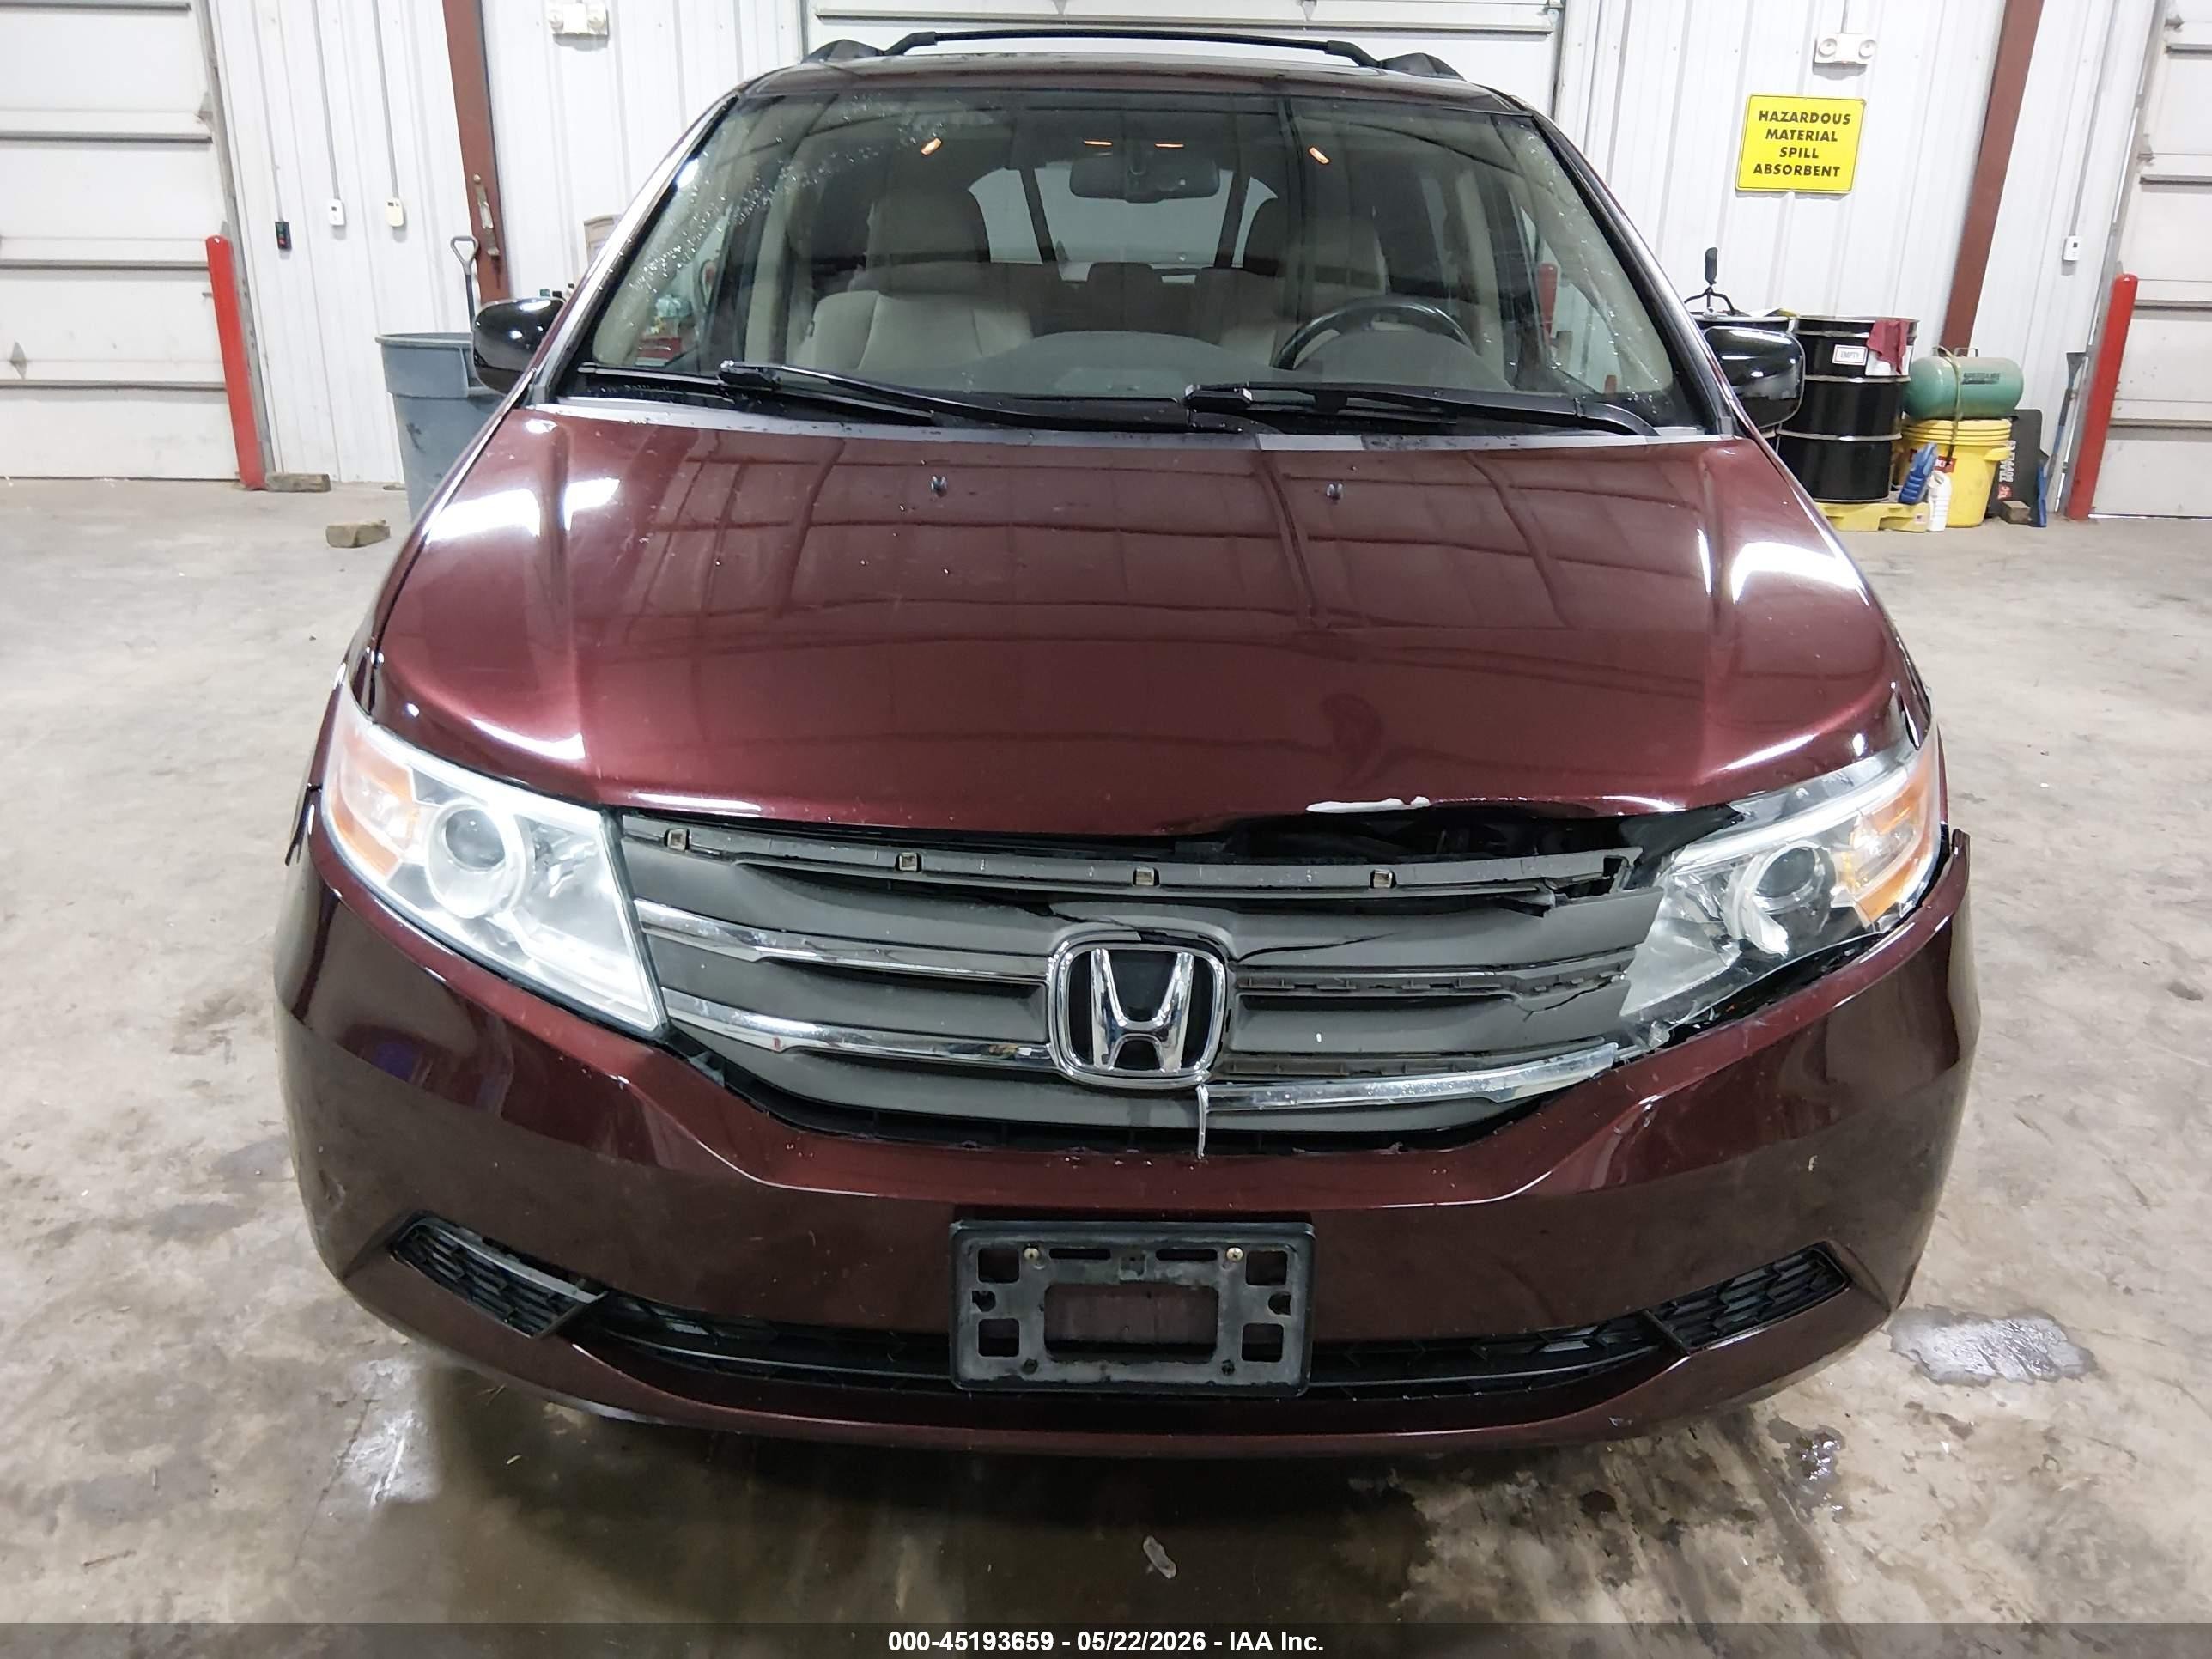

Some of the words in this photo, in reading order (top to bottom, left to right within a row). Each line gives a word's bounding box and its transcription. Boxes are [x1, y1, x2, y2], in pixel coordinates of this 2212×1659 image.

[1758, 110, 1850, 125] HAZARDOUS
[1765, 128, 1838, 142] MATERIAL
[1779, 146, 1819, 158] SPILL
[1753, 163, 1841, 177] ABSORBENT
